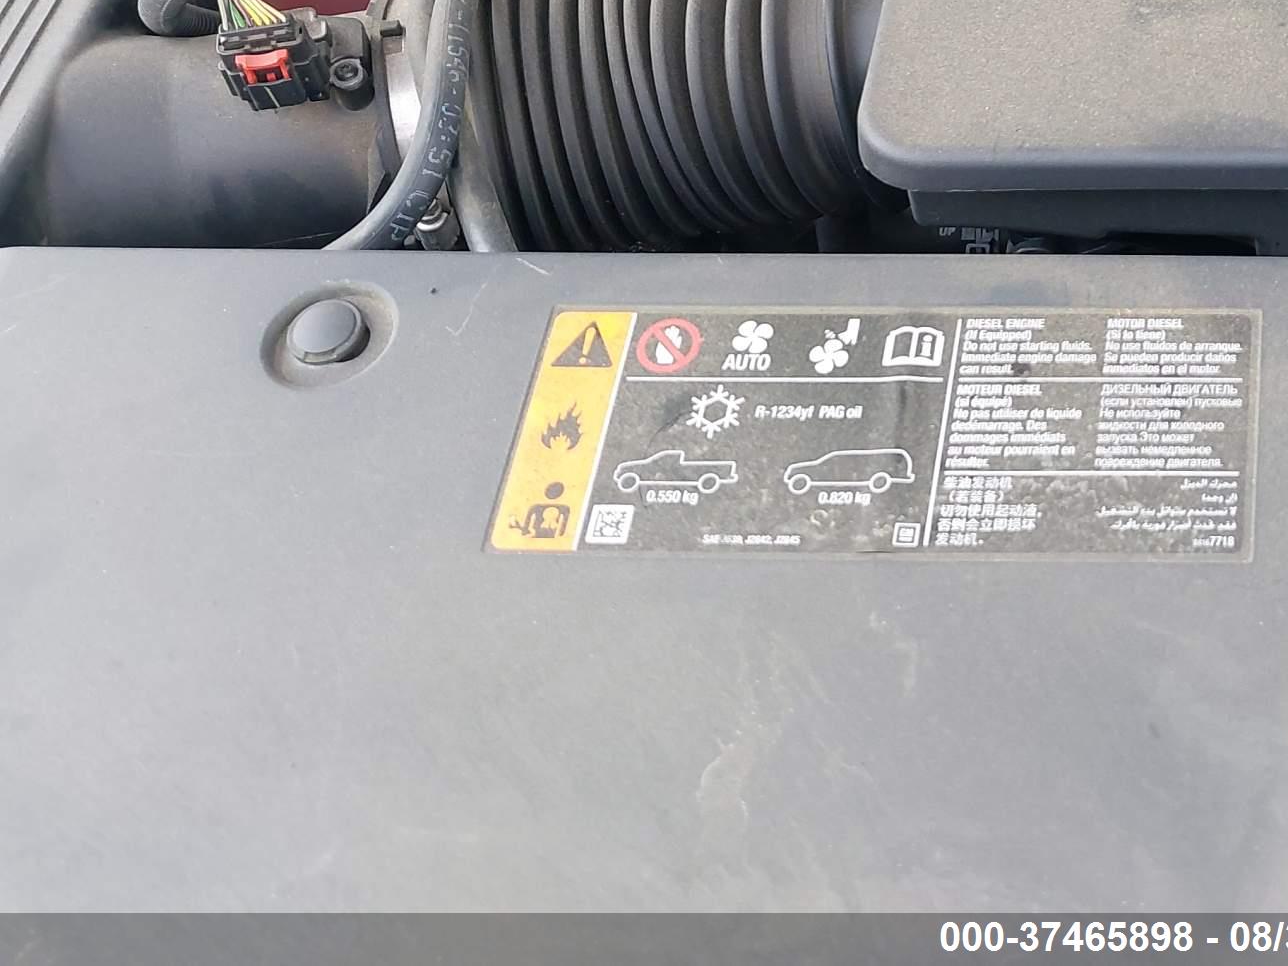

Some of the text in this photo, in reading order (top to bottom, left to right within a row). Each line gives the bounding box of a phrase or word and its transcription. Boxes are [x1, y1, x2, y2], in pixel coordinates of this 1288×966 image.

[939, 227, 956, 236] UP
[966, 318, 1045, 329] DIESEL ENGINE
[1107, 318, 1184, 329] MOTOR DIESEL
[963, 342, 977, 351] Do
[980, 342, 997, 351] not
[999, 343, 1018, 351] use
[1020, 342, 1059, 352] starting
[1122, 342, 1141, 351] use
[722, 353, 772, 371] AUTO
[961, 353, 1097, 364] Immediate engine damage
[959, 366, 979, 375] can
[956, 385, 1042, 395] MOTEUR DIESEL
[754, 406, 862, 420] R-1234yf PAG oil
[646, 490, 699, 505] 0.550 kg
[818, 490, 871, 505] 0.820 kg
